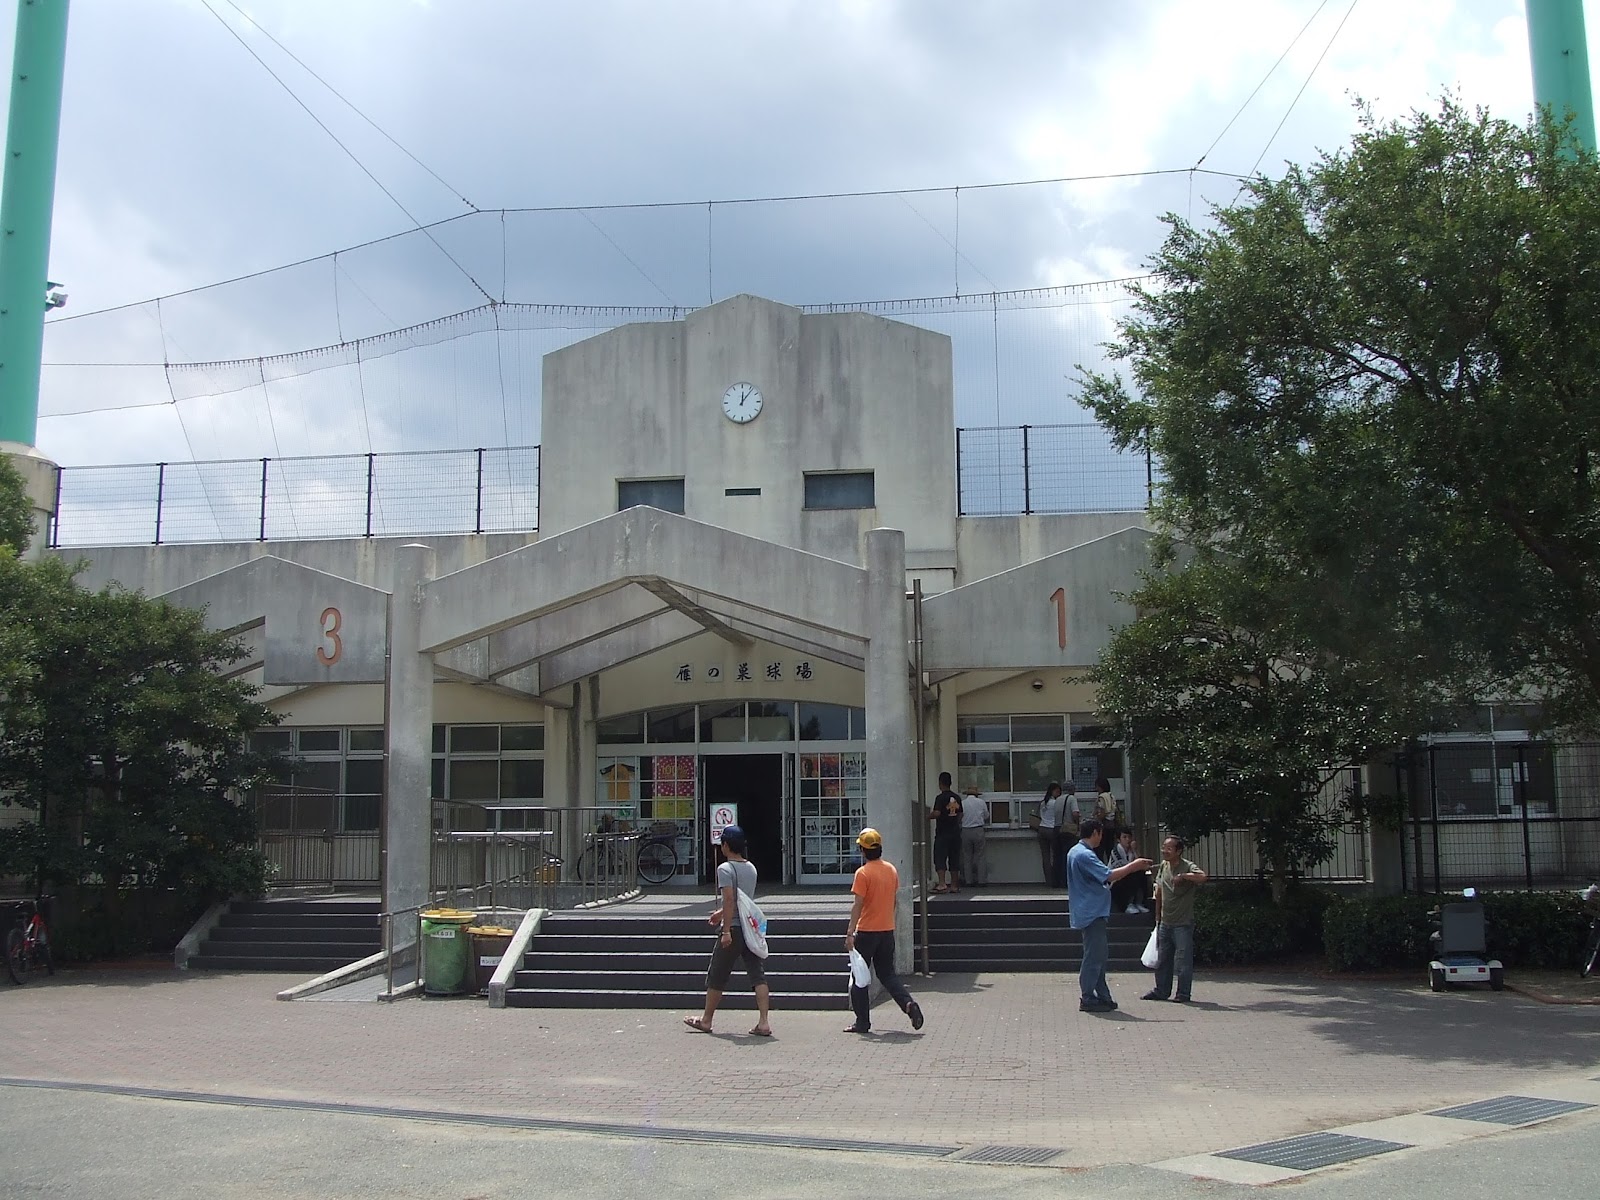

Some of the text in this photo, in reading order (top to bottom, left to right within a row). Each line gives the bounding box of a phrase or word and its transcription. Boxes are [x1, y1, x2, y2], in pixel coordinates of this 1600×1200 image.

[317, 607, 342, 666] 3
[1049, 587, 1066, 649] 1
[676, 662, 812, 681] 雁の巣球場
